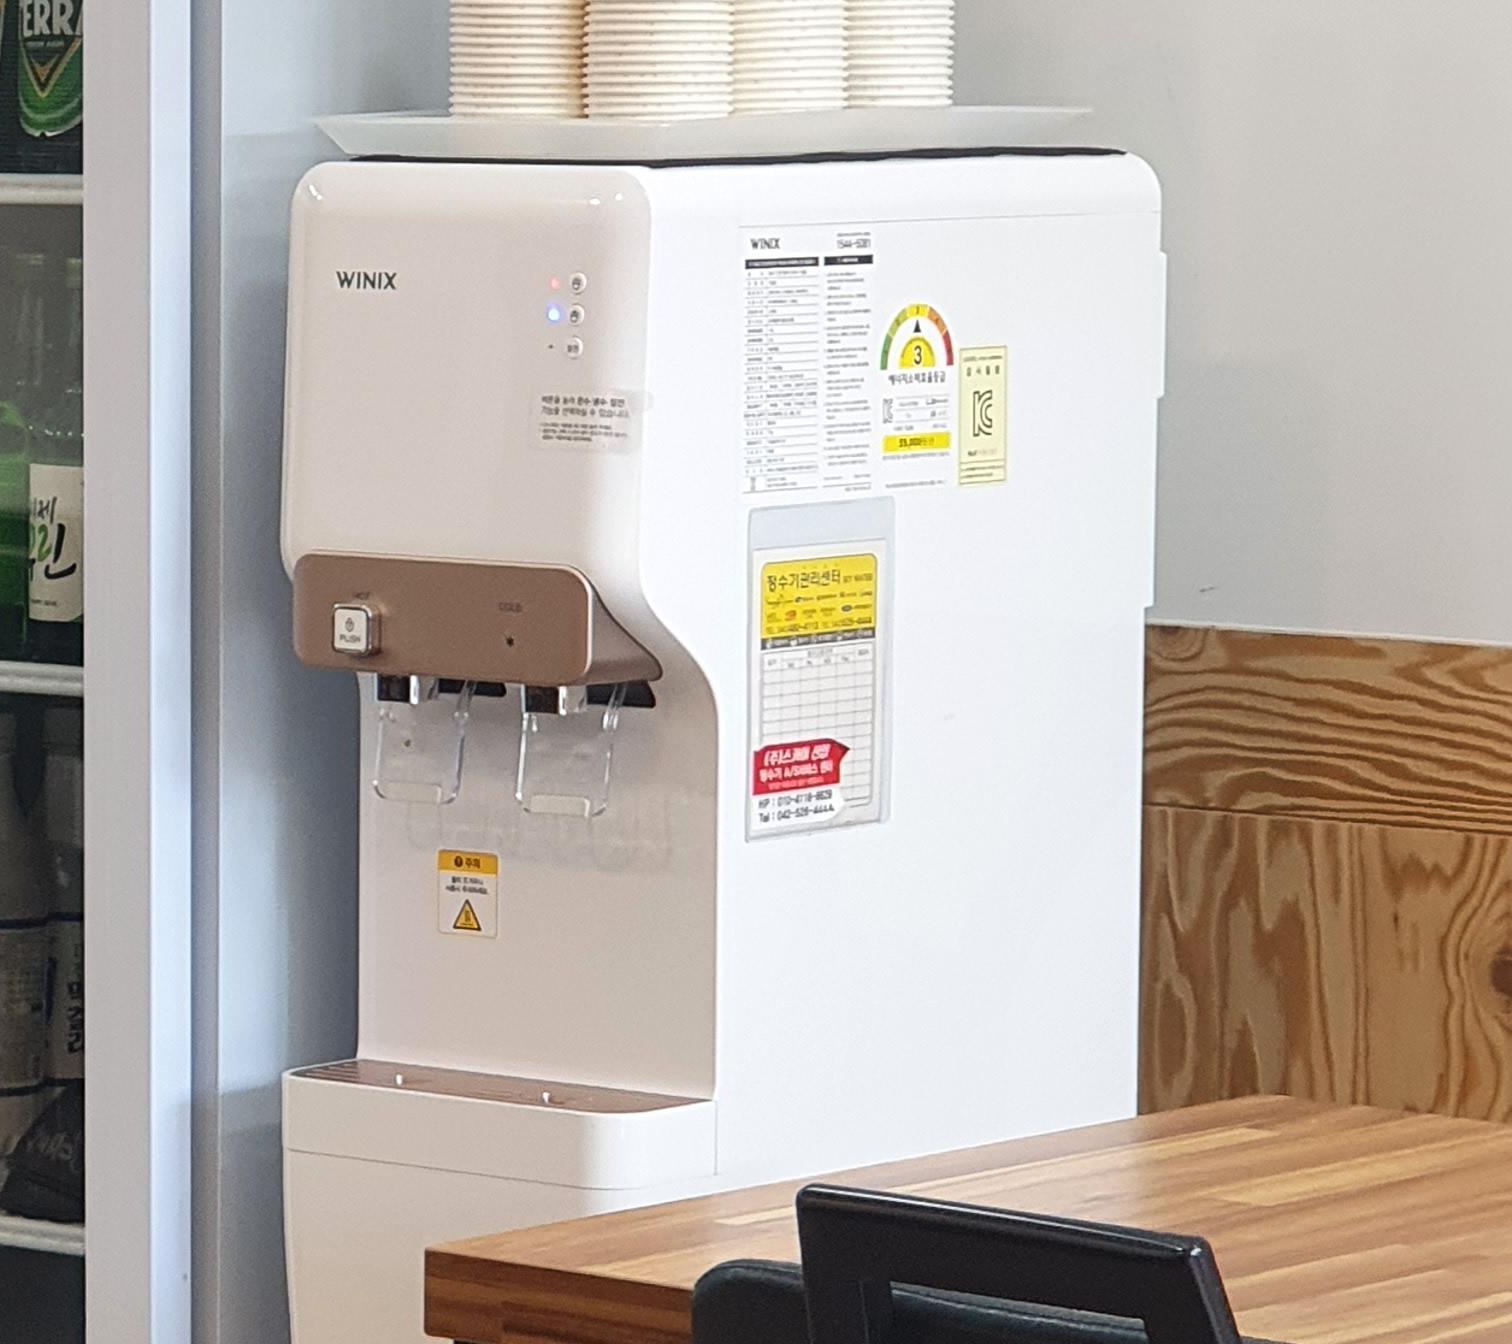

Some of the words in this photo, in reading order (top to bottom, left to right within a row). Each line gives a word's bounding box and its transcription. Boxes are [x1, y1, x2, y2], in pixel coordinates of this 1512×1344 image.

[750, 237, 781, 251] WINIX
[335, 270, 398, 290] WINIX
[913, 344, 923, 365] 3
[767, 568, 841, 594] 정수기관리센터
